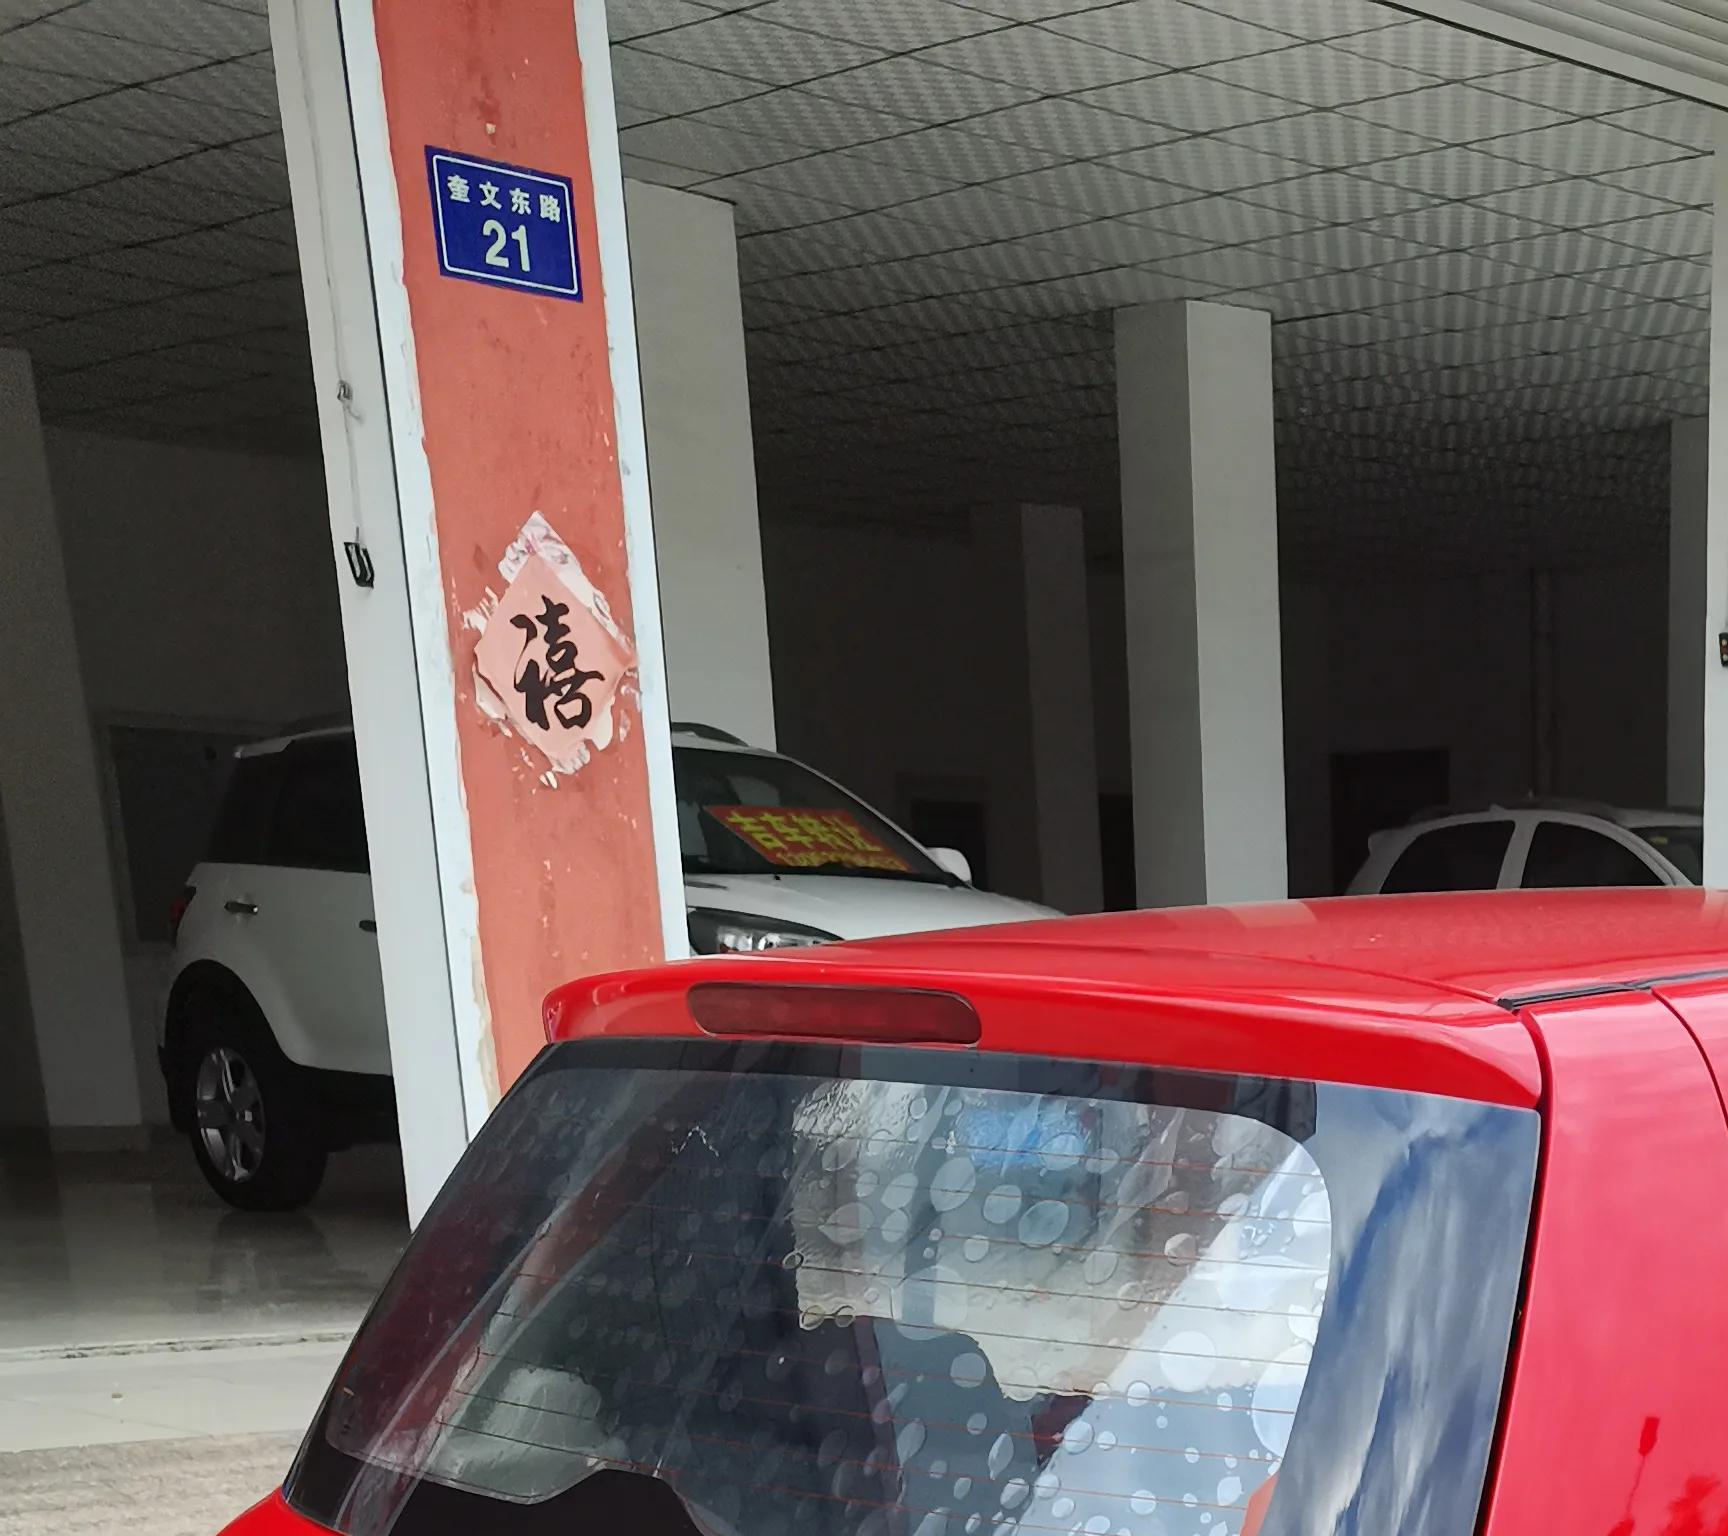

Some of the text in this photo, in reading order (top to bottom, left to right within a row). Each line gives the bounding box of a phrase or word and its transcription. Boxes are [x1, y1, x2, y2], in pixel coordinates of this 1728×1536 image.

[447, 174, 561, 223] 奎文东路
[482, 218, 531, 273] 21
